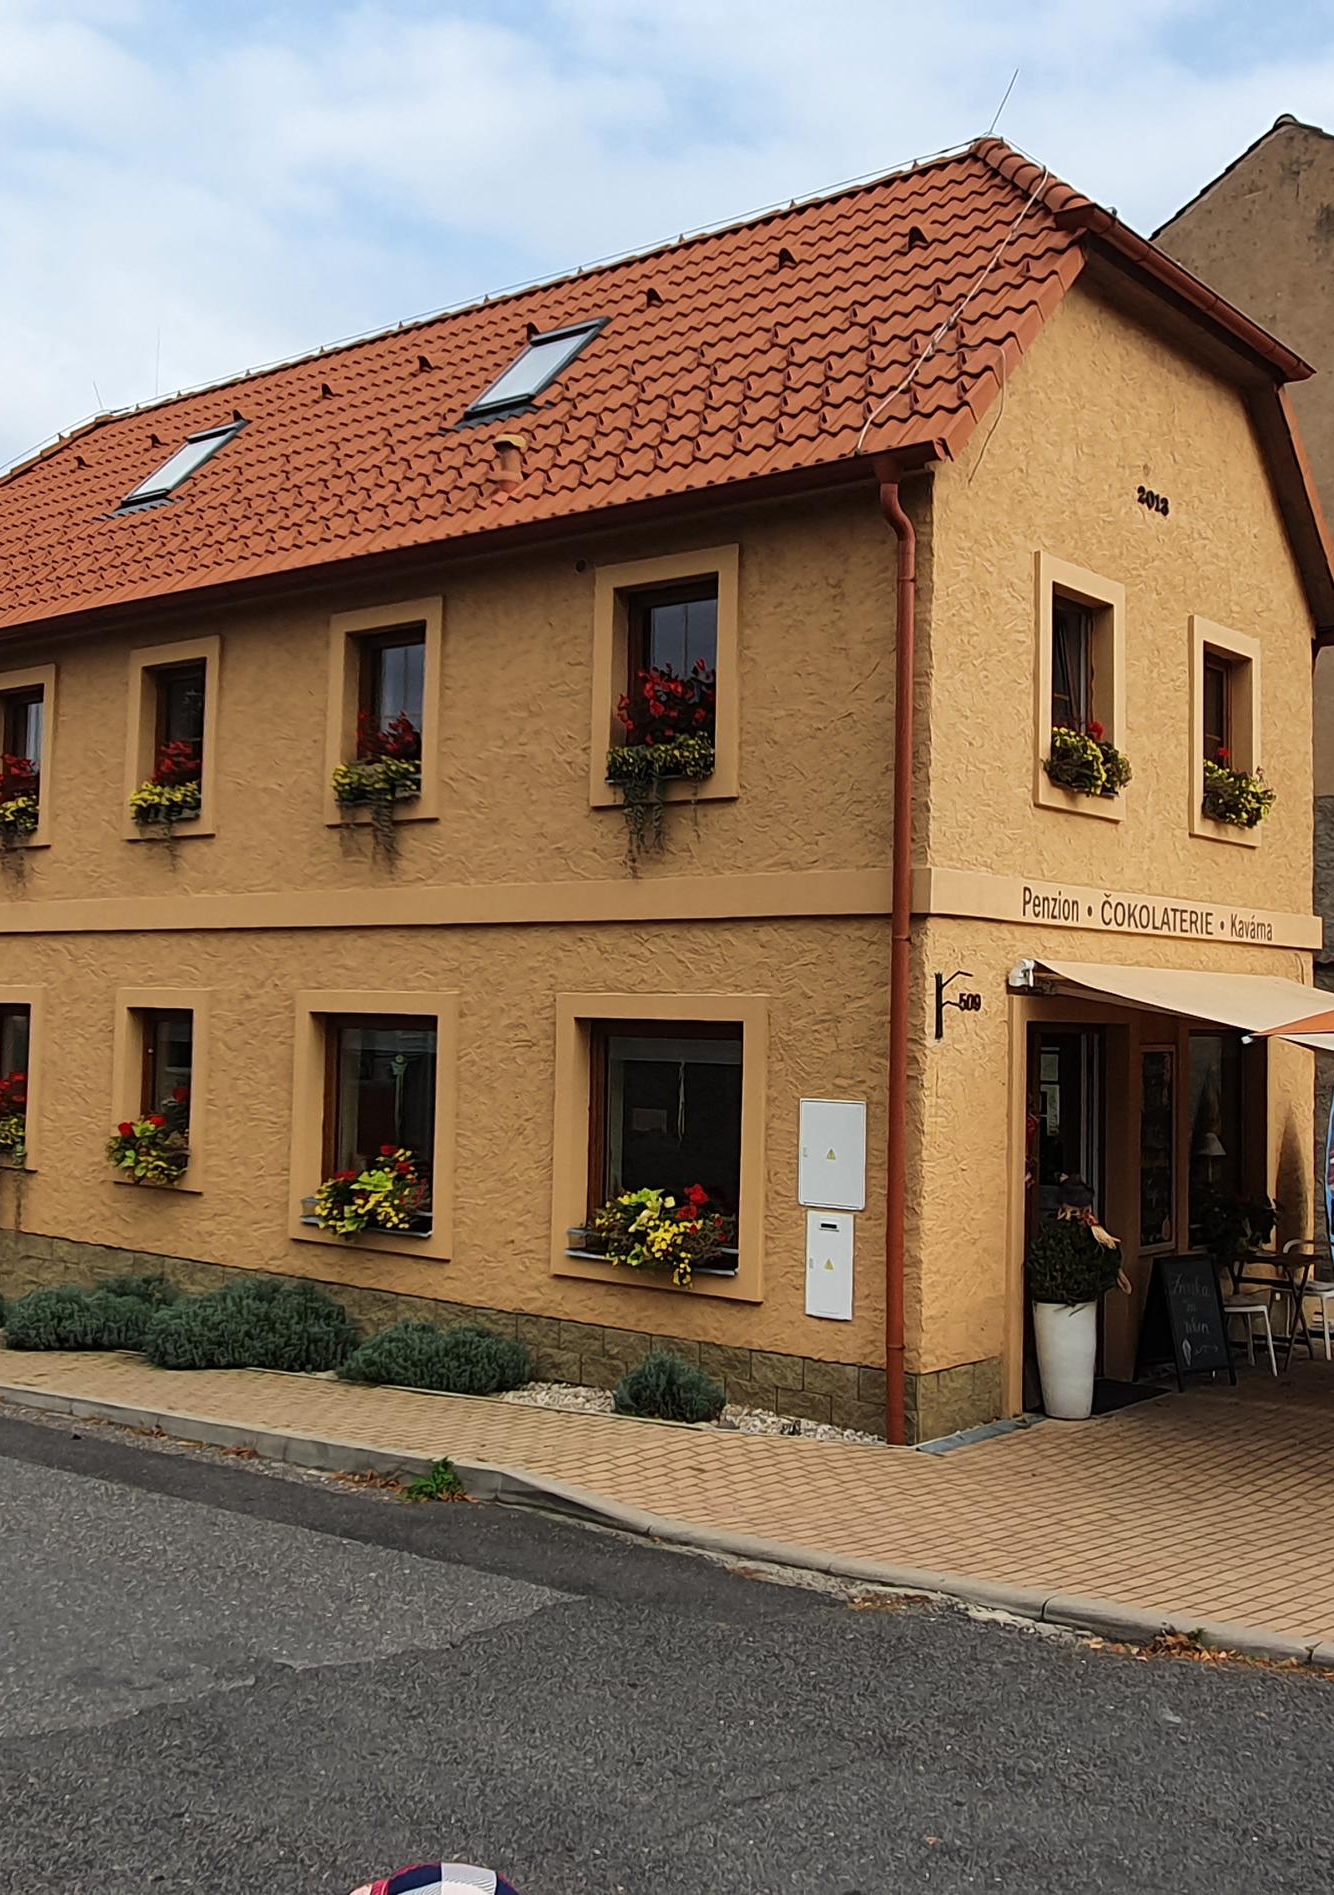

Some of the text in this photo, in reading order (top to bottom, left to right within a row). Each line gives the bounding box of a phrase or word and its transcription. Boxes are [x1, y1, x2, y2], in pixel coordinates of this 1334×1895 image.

[1022, 886, 1273, 941] Penzion ČOKOLATERIE Kavárna
[959, 992, 981, 1012] 509
